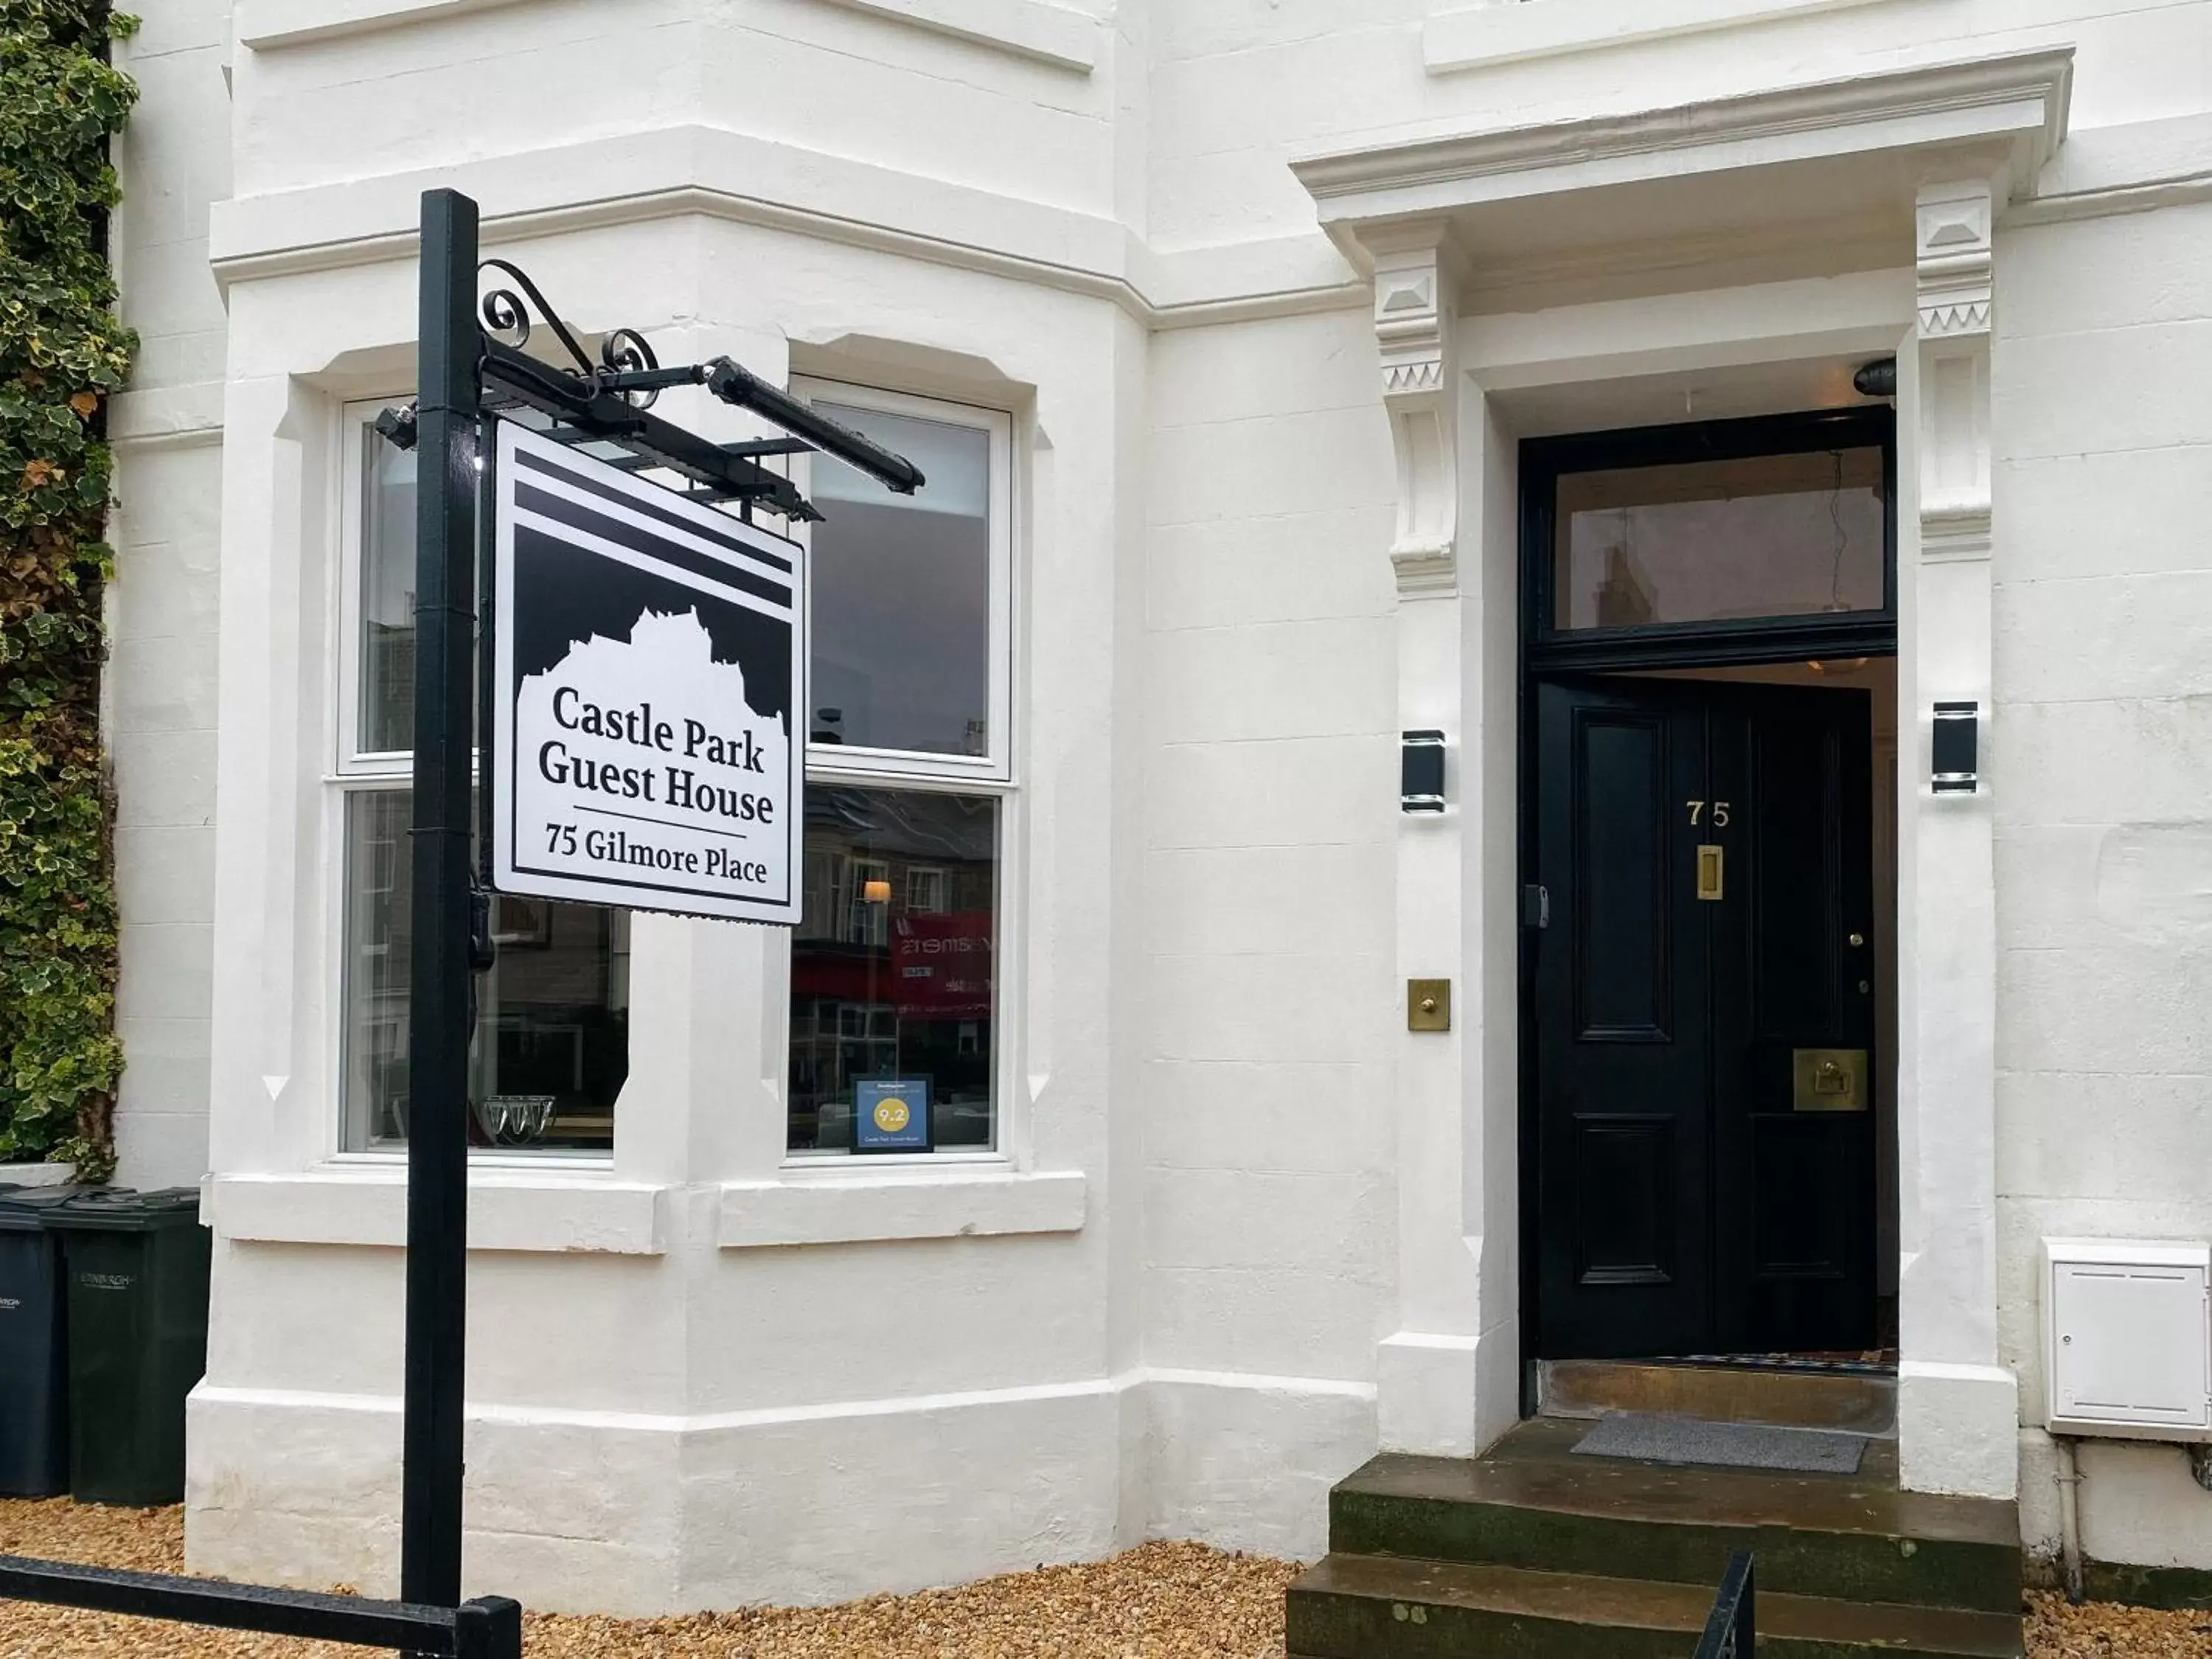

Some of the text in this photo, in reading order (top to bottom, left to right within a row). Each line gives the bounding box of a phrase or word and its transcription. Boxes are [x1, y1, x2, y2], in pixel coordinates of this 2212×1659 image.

[552, 686, 765, 773] Castle Park
[539, 740, 773, 824] Guest House
[1686, 801, 1730, 827] 75
[546, 823, 768, 884] 75 Gilmore Place
[878, 1108, 905, 1121] 9.2
